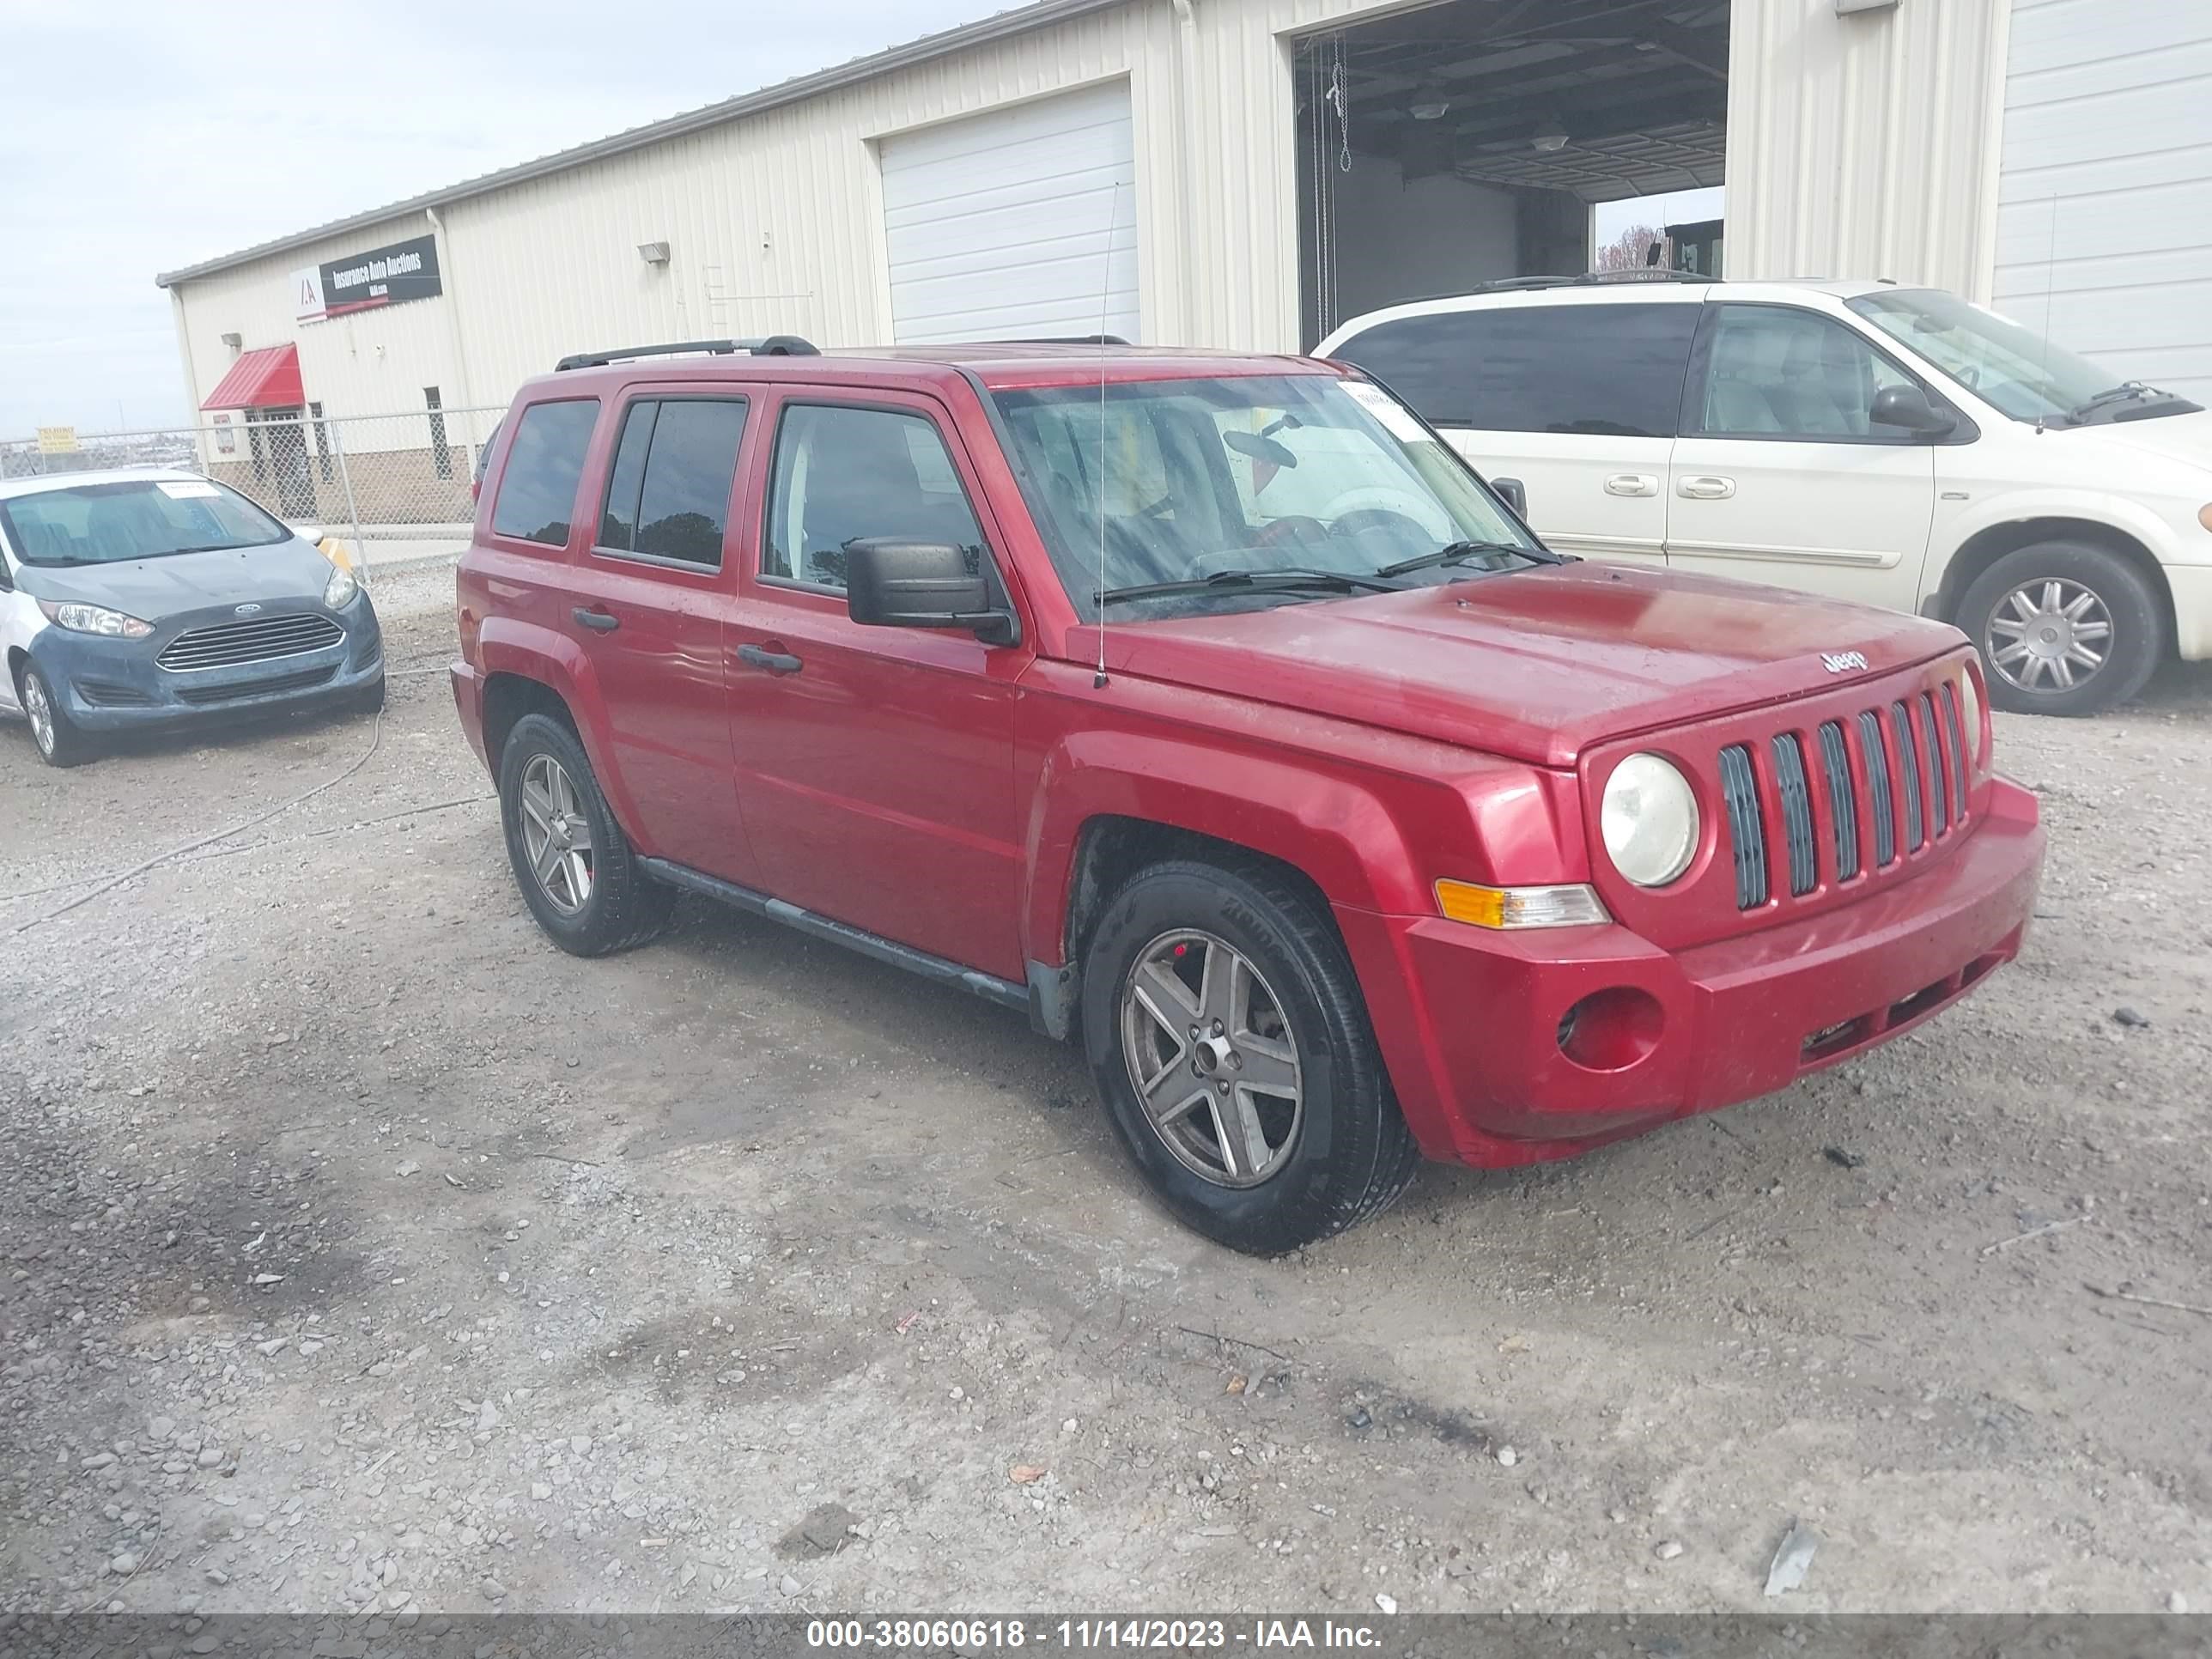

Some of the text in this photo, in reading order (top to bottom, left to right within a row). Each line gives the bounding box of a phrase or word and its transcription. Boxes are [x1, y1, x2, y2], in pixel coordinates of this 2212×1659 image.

[332, 252, 421, 289] Insurance Auto Auctions
[1820, 651, 1868, 673] Jeep
